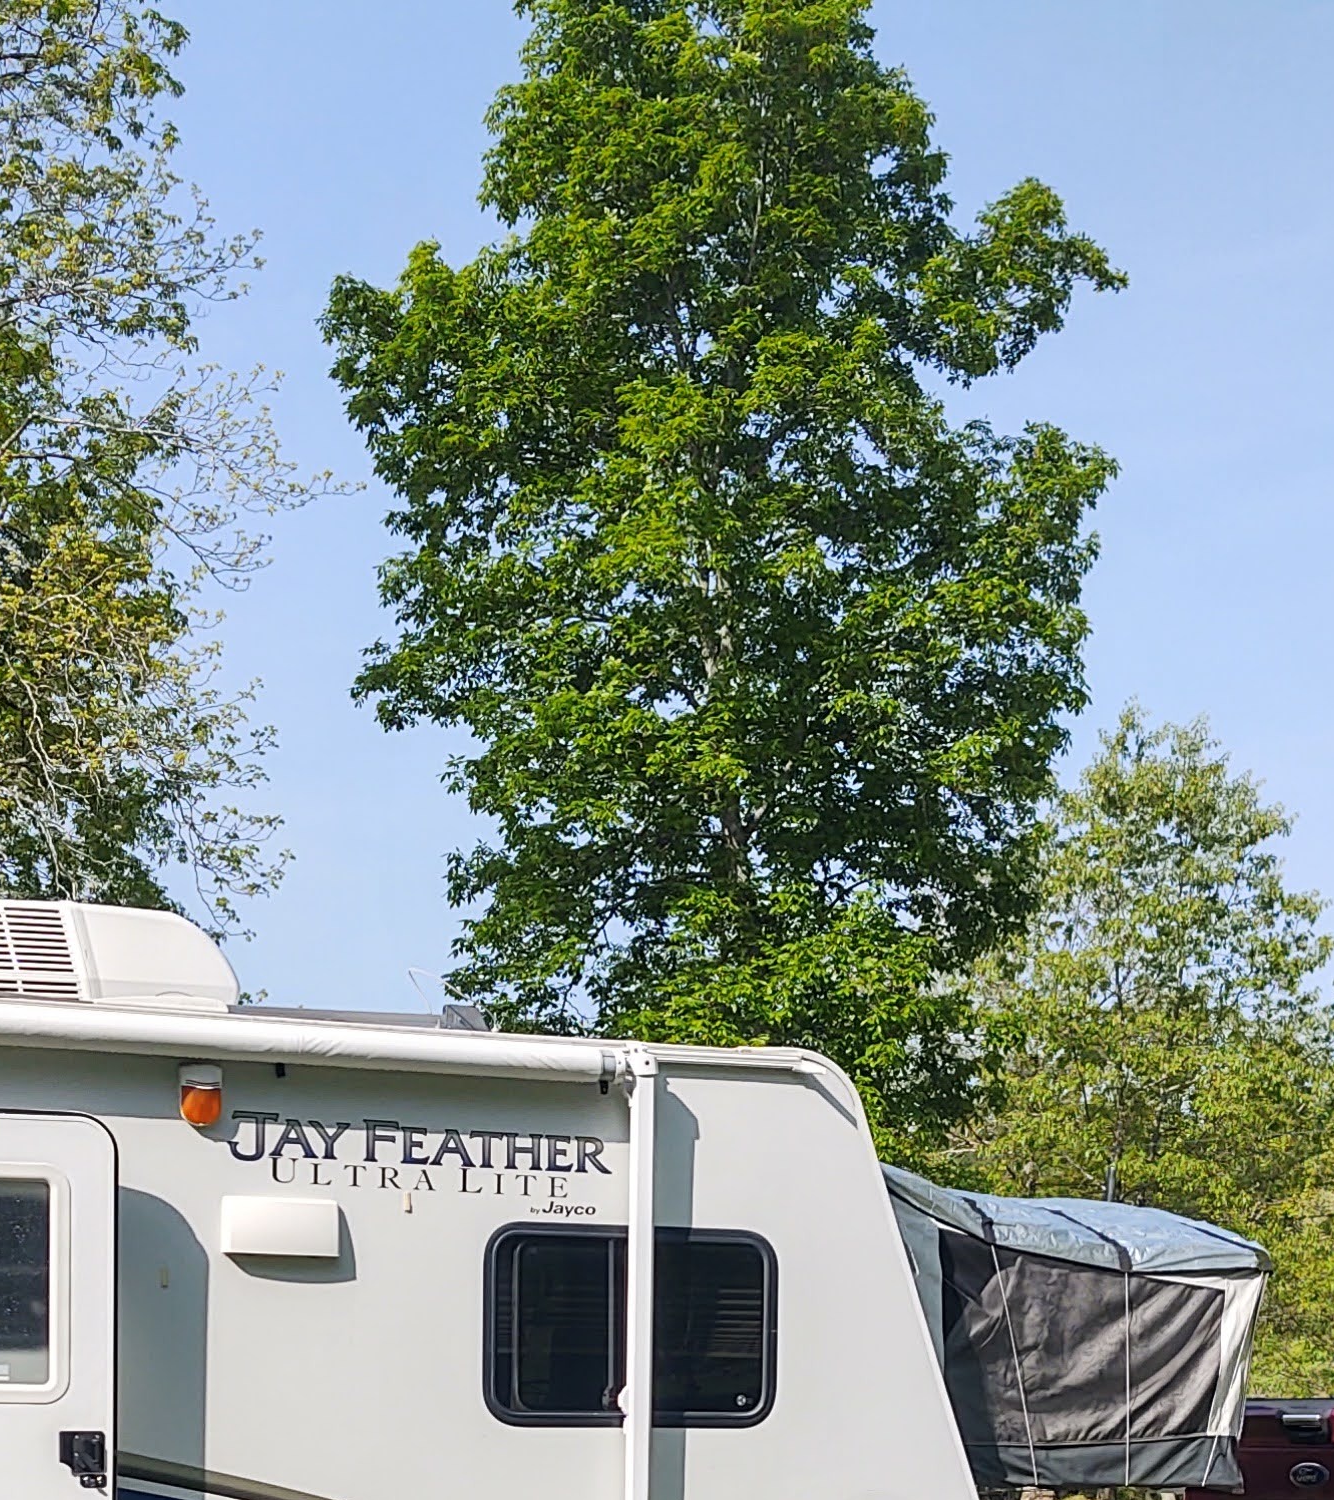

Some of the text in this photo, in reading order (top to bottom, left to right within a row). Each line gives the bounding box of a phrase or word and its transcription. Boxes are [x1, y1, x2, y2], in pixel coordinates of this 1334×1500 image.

[227, 1110, 613, 1175] JAY FEATHER
[269, 1156, 569, 1198] ULTRA LITE
[530, 1201, 597, 1217] by Jayco
